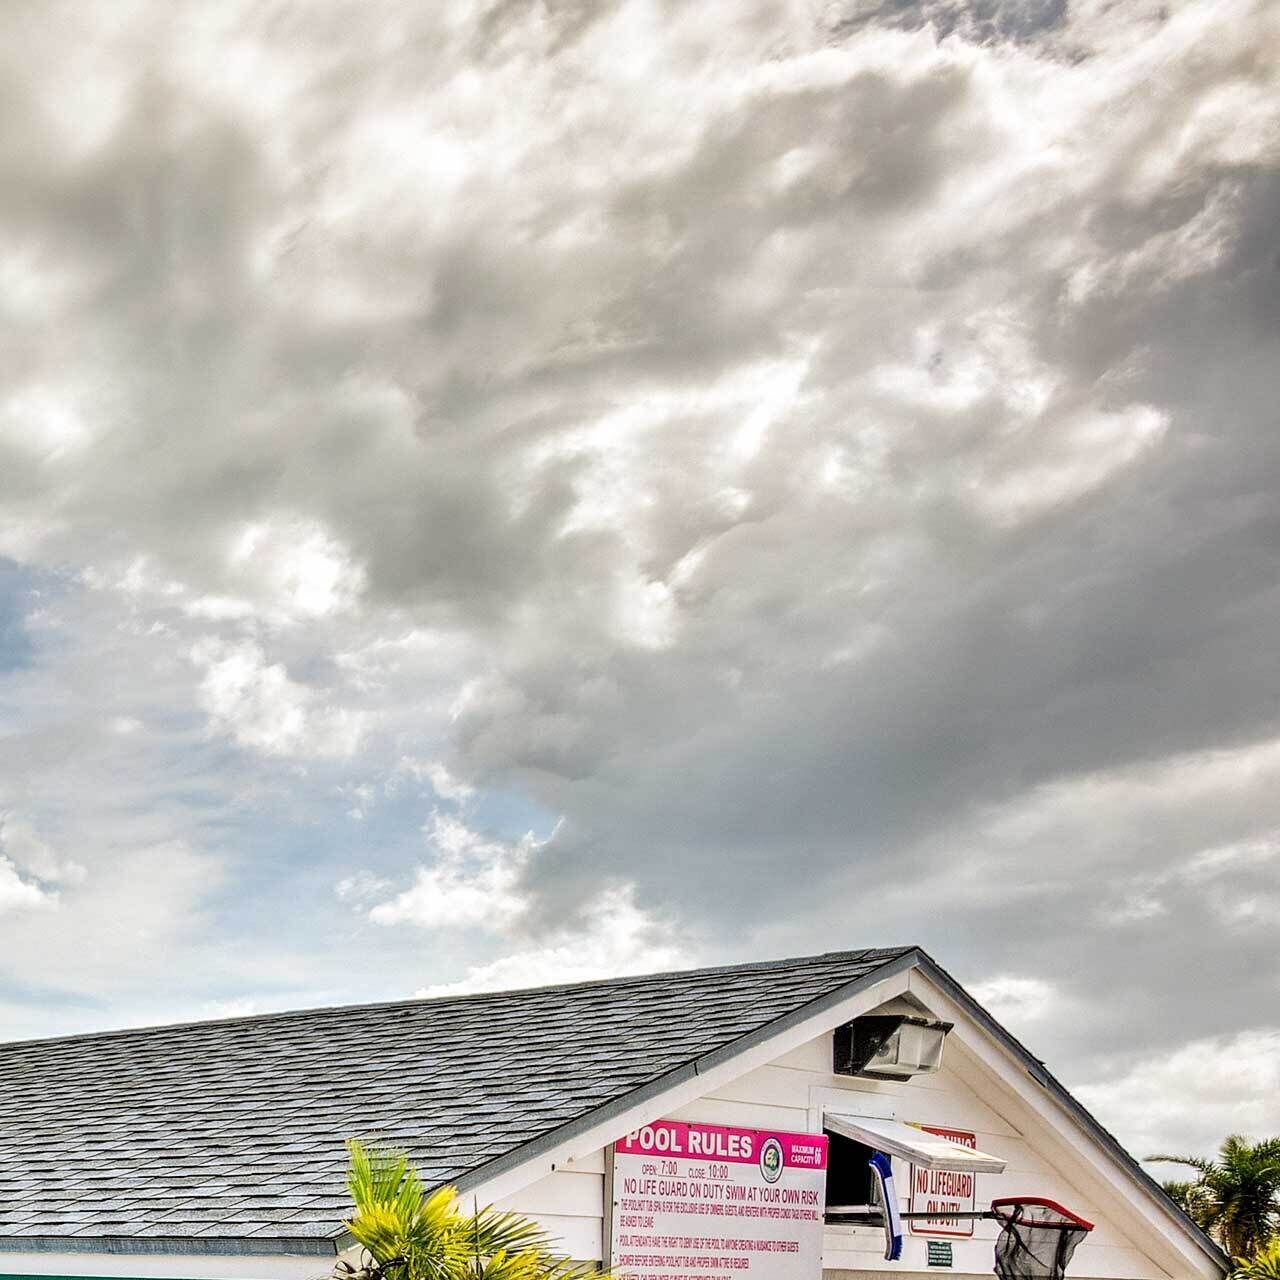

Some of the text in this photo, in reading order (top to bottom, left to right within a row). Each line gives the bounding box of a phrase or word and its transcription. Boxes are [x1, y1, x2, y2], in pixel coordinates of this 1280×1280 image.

[625, 1127, 752, 1158] POOL RULES
[791, 1144, 814, 1154] MAXIMUM
[661, 1160, 678, 1175] 7:00
[709, 1164, 728, 1179] 10:00
[791, 1154, 814, 1164] CAPACITY
[624, 1178, 818, 1205] NO LIFE GUARD ON DUTY SWIM AT YOUR OWN RISK
[916, 1169, 972, 1198] NO LIFEGUARD
[927, 1200, 960, 1226] ON DUTY
